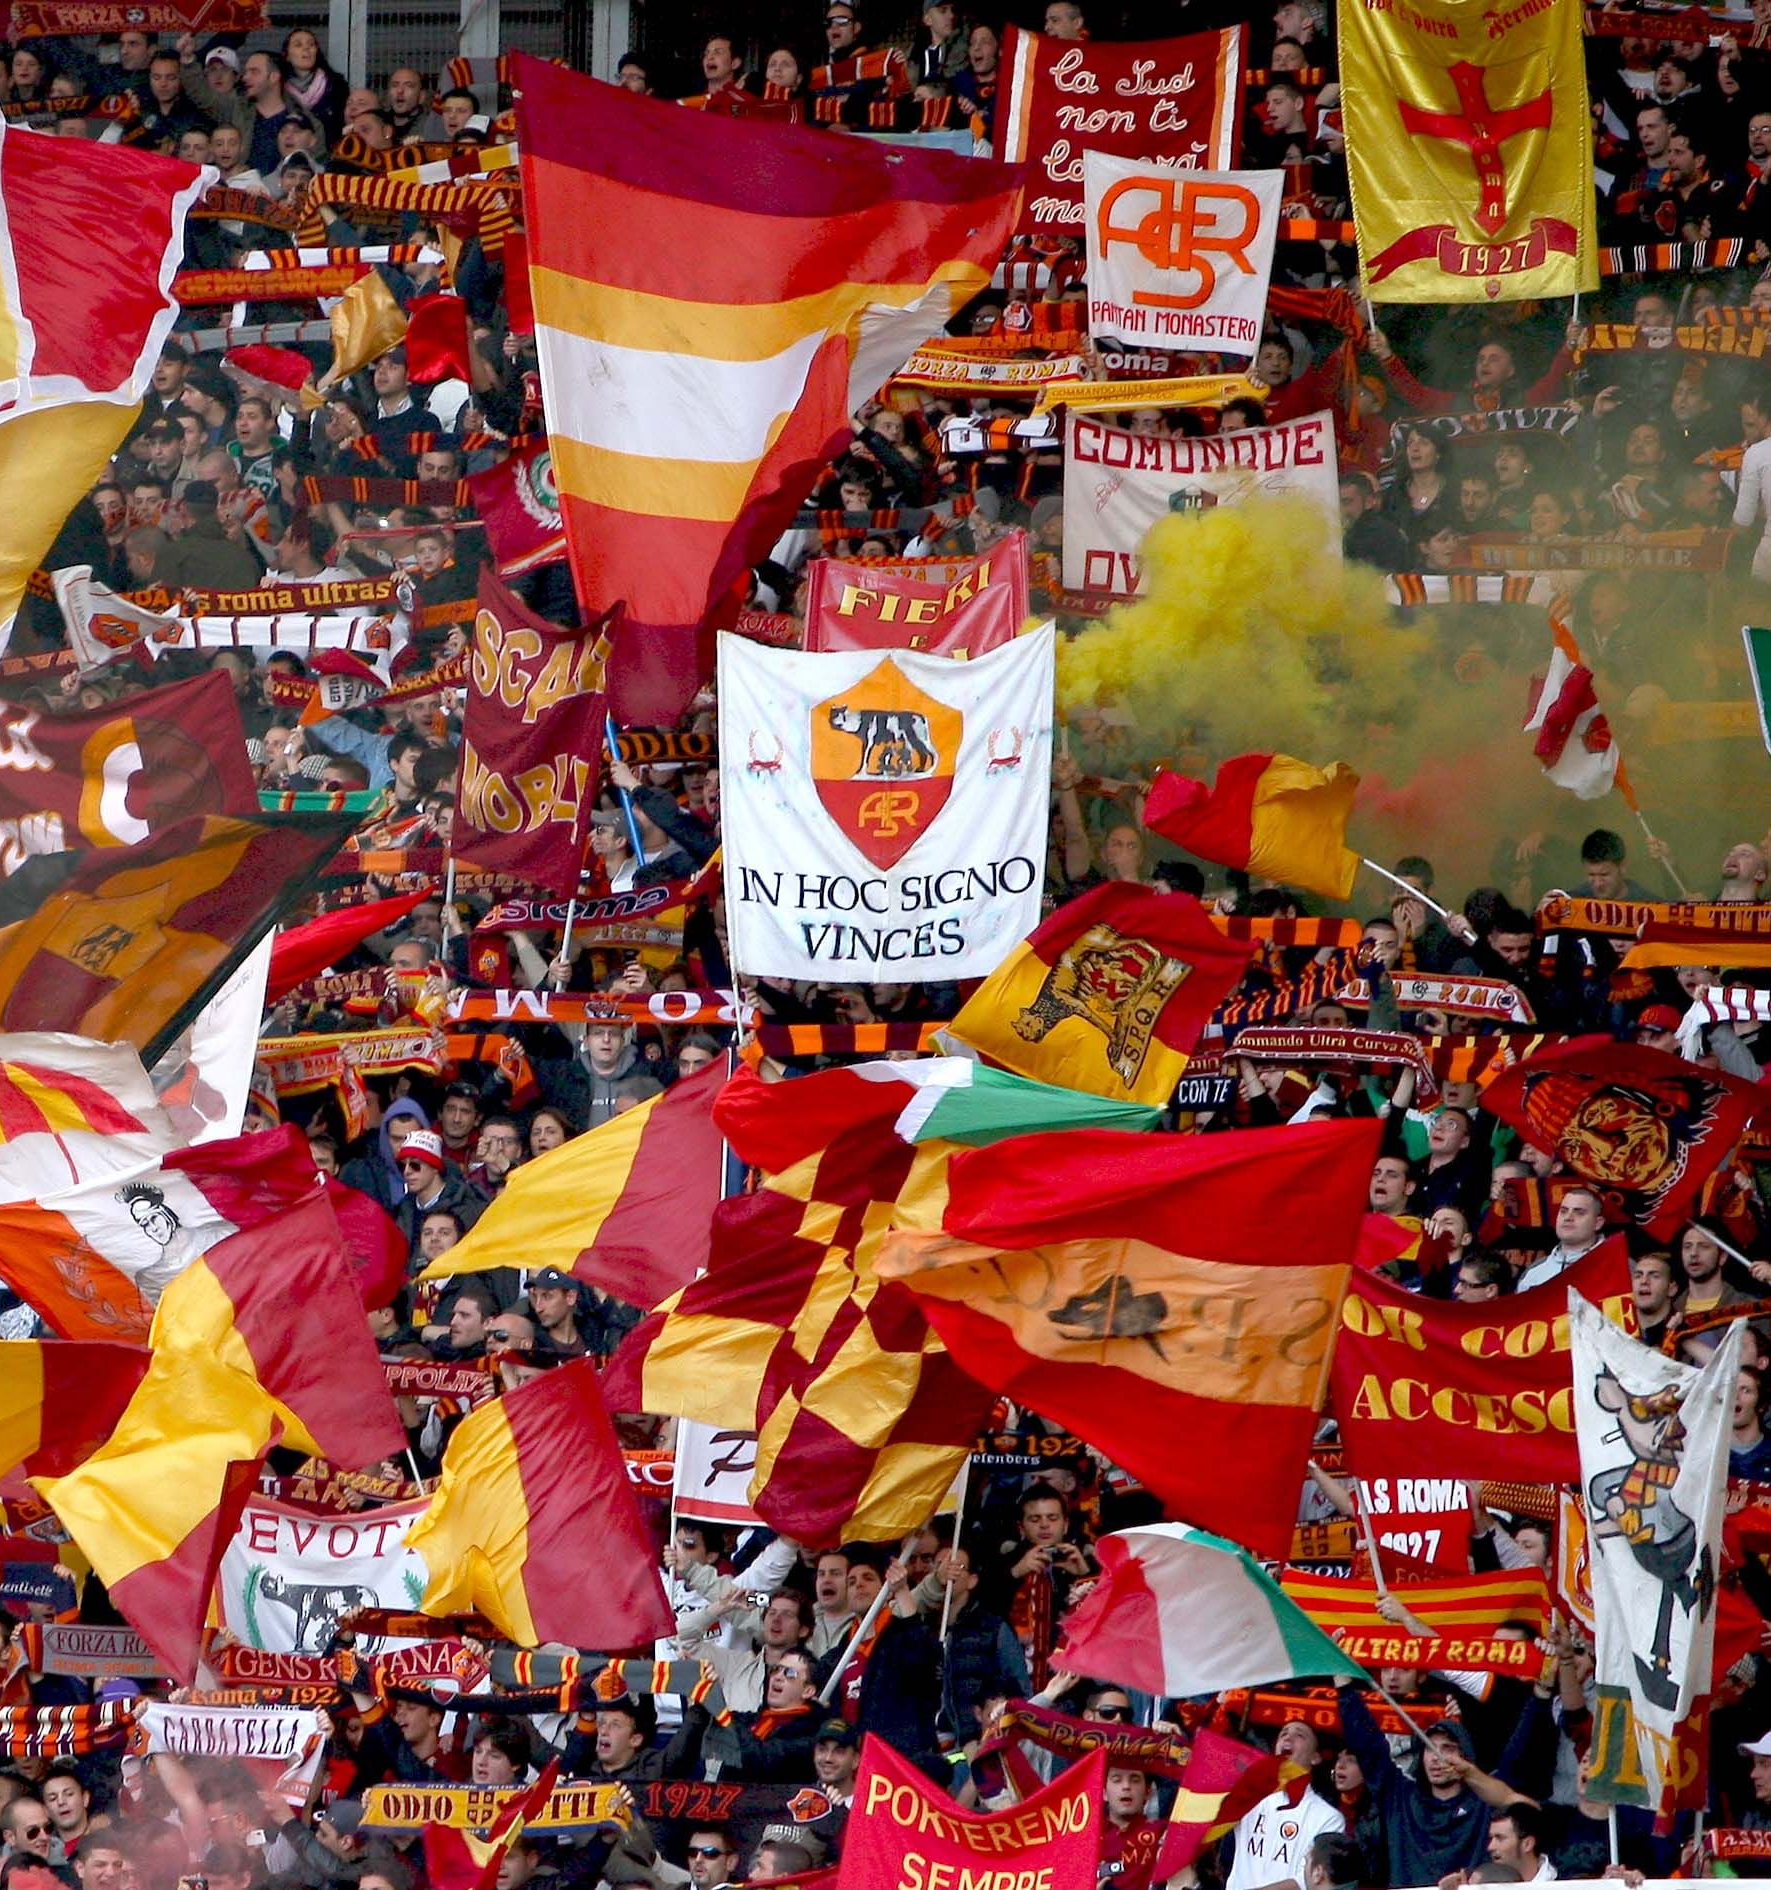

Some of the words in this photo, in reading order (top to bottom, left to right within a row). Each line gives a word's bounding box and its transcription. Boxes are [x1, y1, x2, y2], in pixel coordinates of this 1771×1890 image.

[1056, 105, 1136, 134] non
[1458, 238, 1532, 275] 1927
[1154, 311, 1258, 343] MONASTERO
[1072, 421, 1325, 474] COMUNQUE
[217, 582, 296, 612] roma
[305, 578, 391, 607] ultras
[838, 560, 991, 625] FIERI
[739, 865, 781, 906] IN
[796, 872, 888, 914] HOC
[900, 856, 1037, 912] SIGNO
[801, 917, 967, 963] VINCES
[1235, 1035, 1304, 1049] ommando
[1353, 1035, 1397, 1054] Curva
[1178, 1079, 1210, 1104] CON
[1407, 1479, 1469, 1512] ROMA
[56, 1633, 117, 1658] FORZA
[1445, 1640, 1527, 1665] ROMA
[235, 1646, 315, 1681] GENS
[163, 1717, 299, 1757] GARBATELLA
[382, 1793, 454, 1822] ODIO
[644, 1781, 744, 1821] 1927
[866, 1773, 1090, 1853] PORTEREMO
